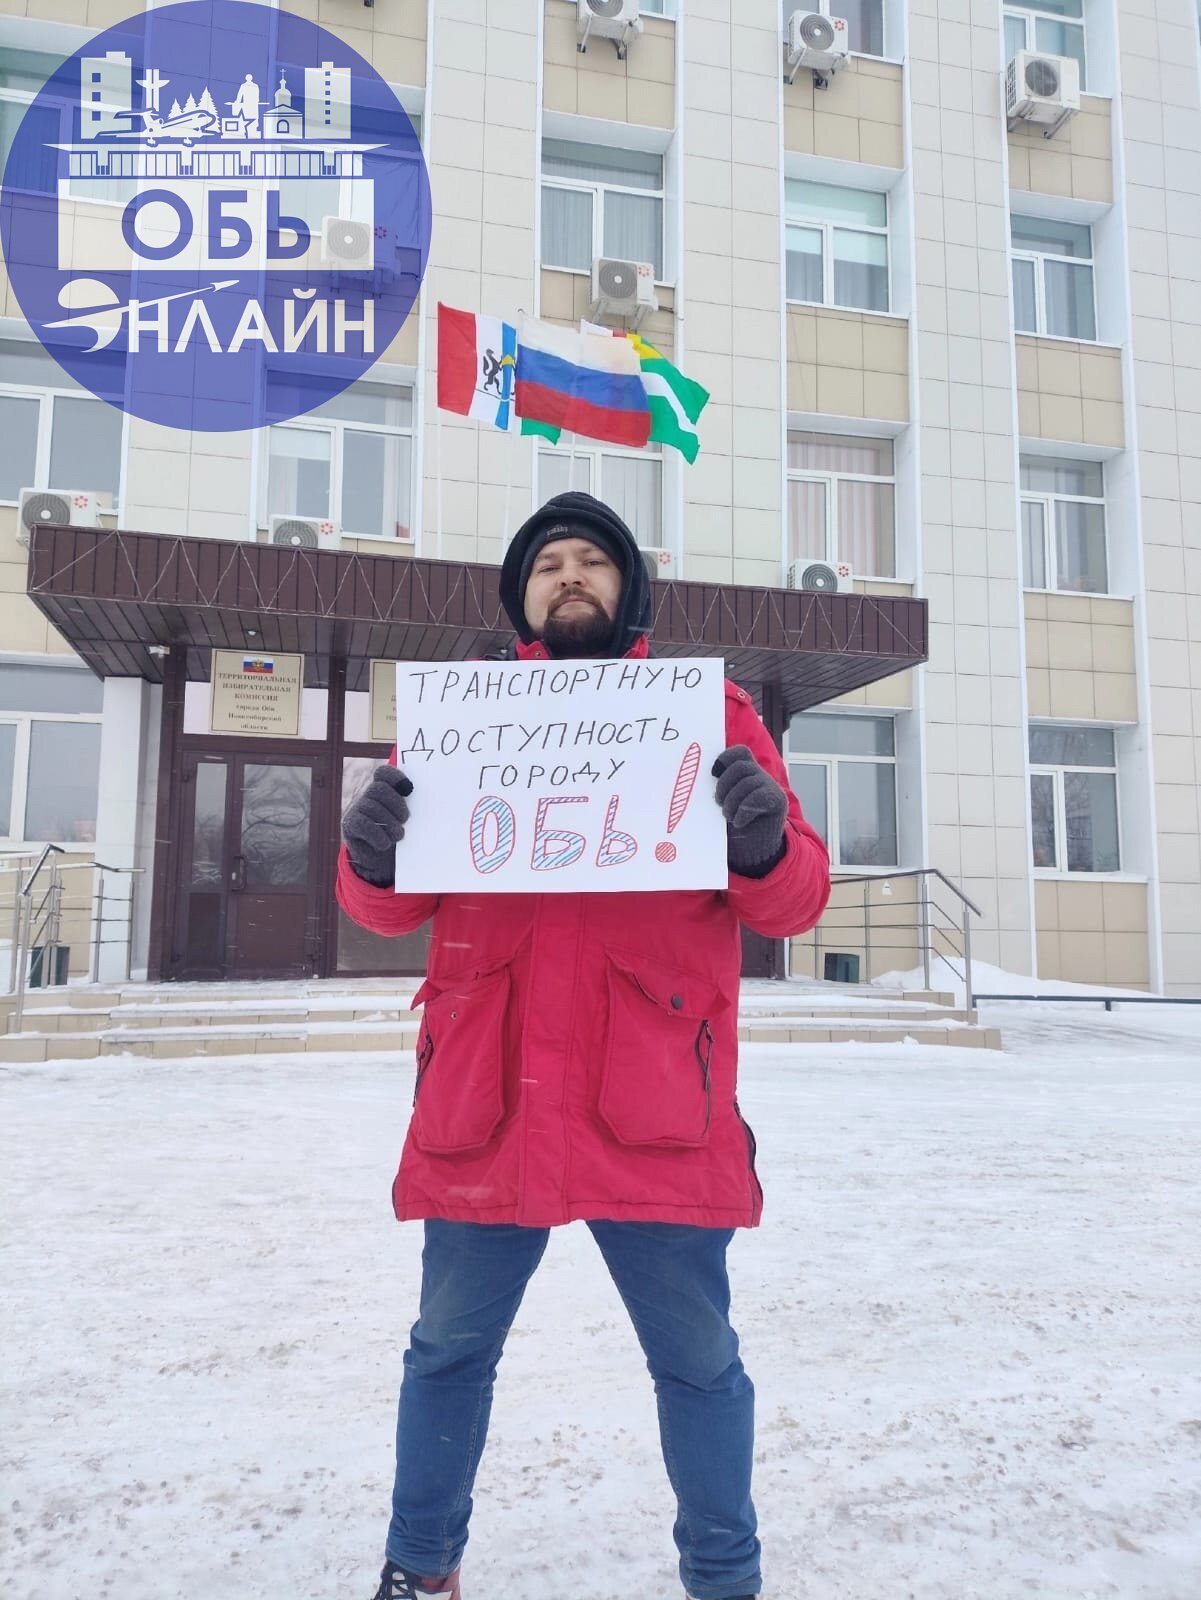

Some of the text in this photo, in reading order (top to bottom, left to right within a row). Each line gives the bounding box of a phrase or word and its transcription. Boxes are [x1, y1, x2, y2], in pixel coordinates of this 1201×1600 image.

[218, 672, 297, 683] ТЕРРИТОРИАЛЬНАЯ
[222, 682, 291, 693] ИЗБИРАТЕЛЬНАЯ
[409, 662, 702, 703] ТРАНСПОРТНУЮ
[234, 692, 278, 702] КОМИССИЯ
[401, 717, 680, 764] ДОСТУПНОСТЬ
[478, 758, 625, 790] ГОРОДУ
